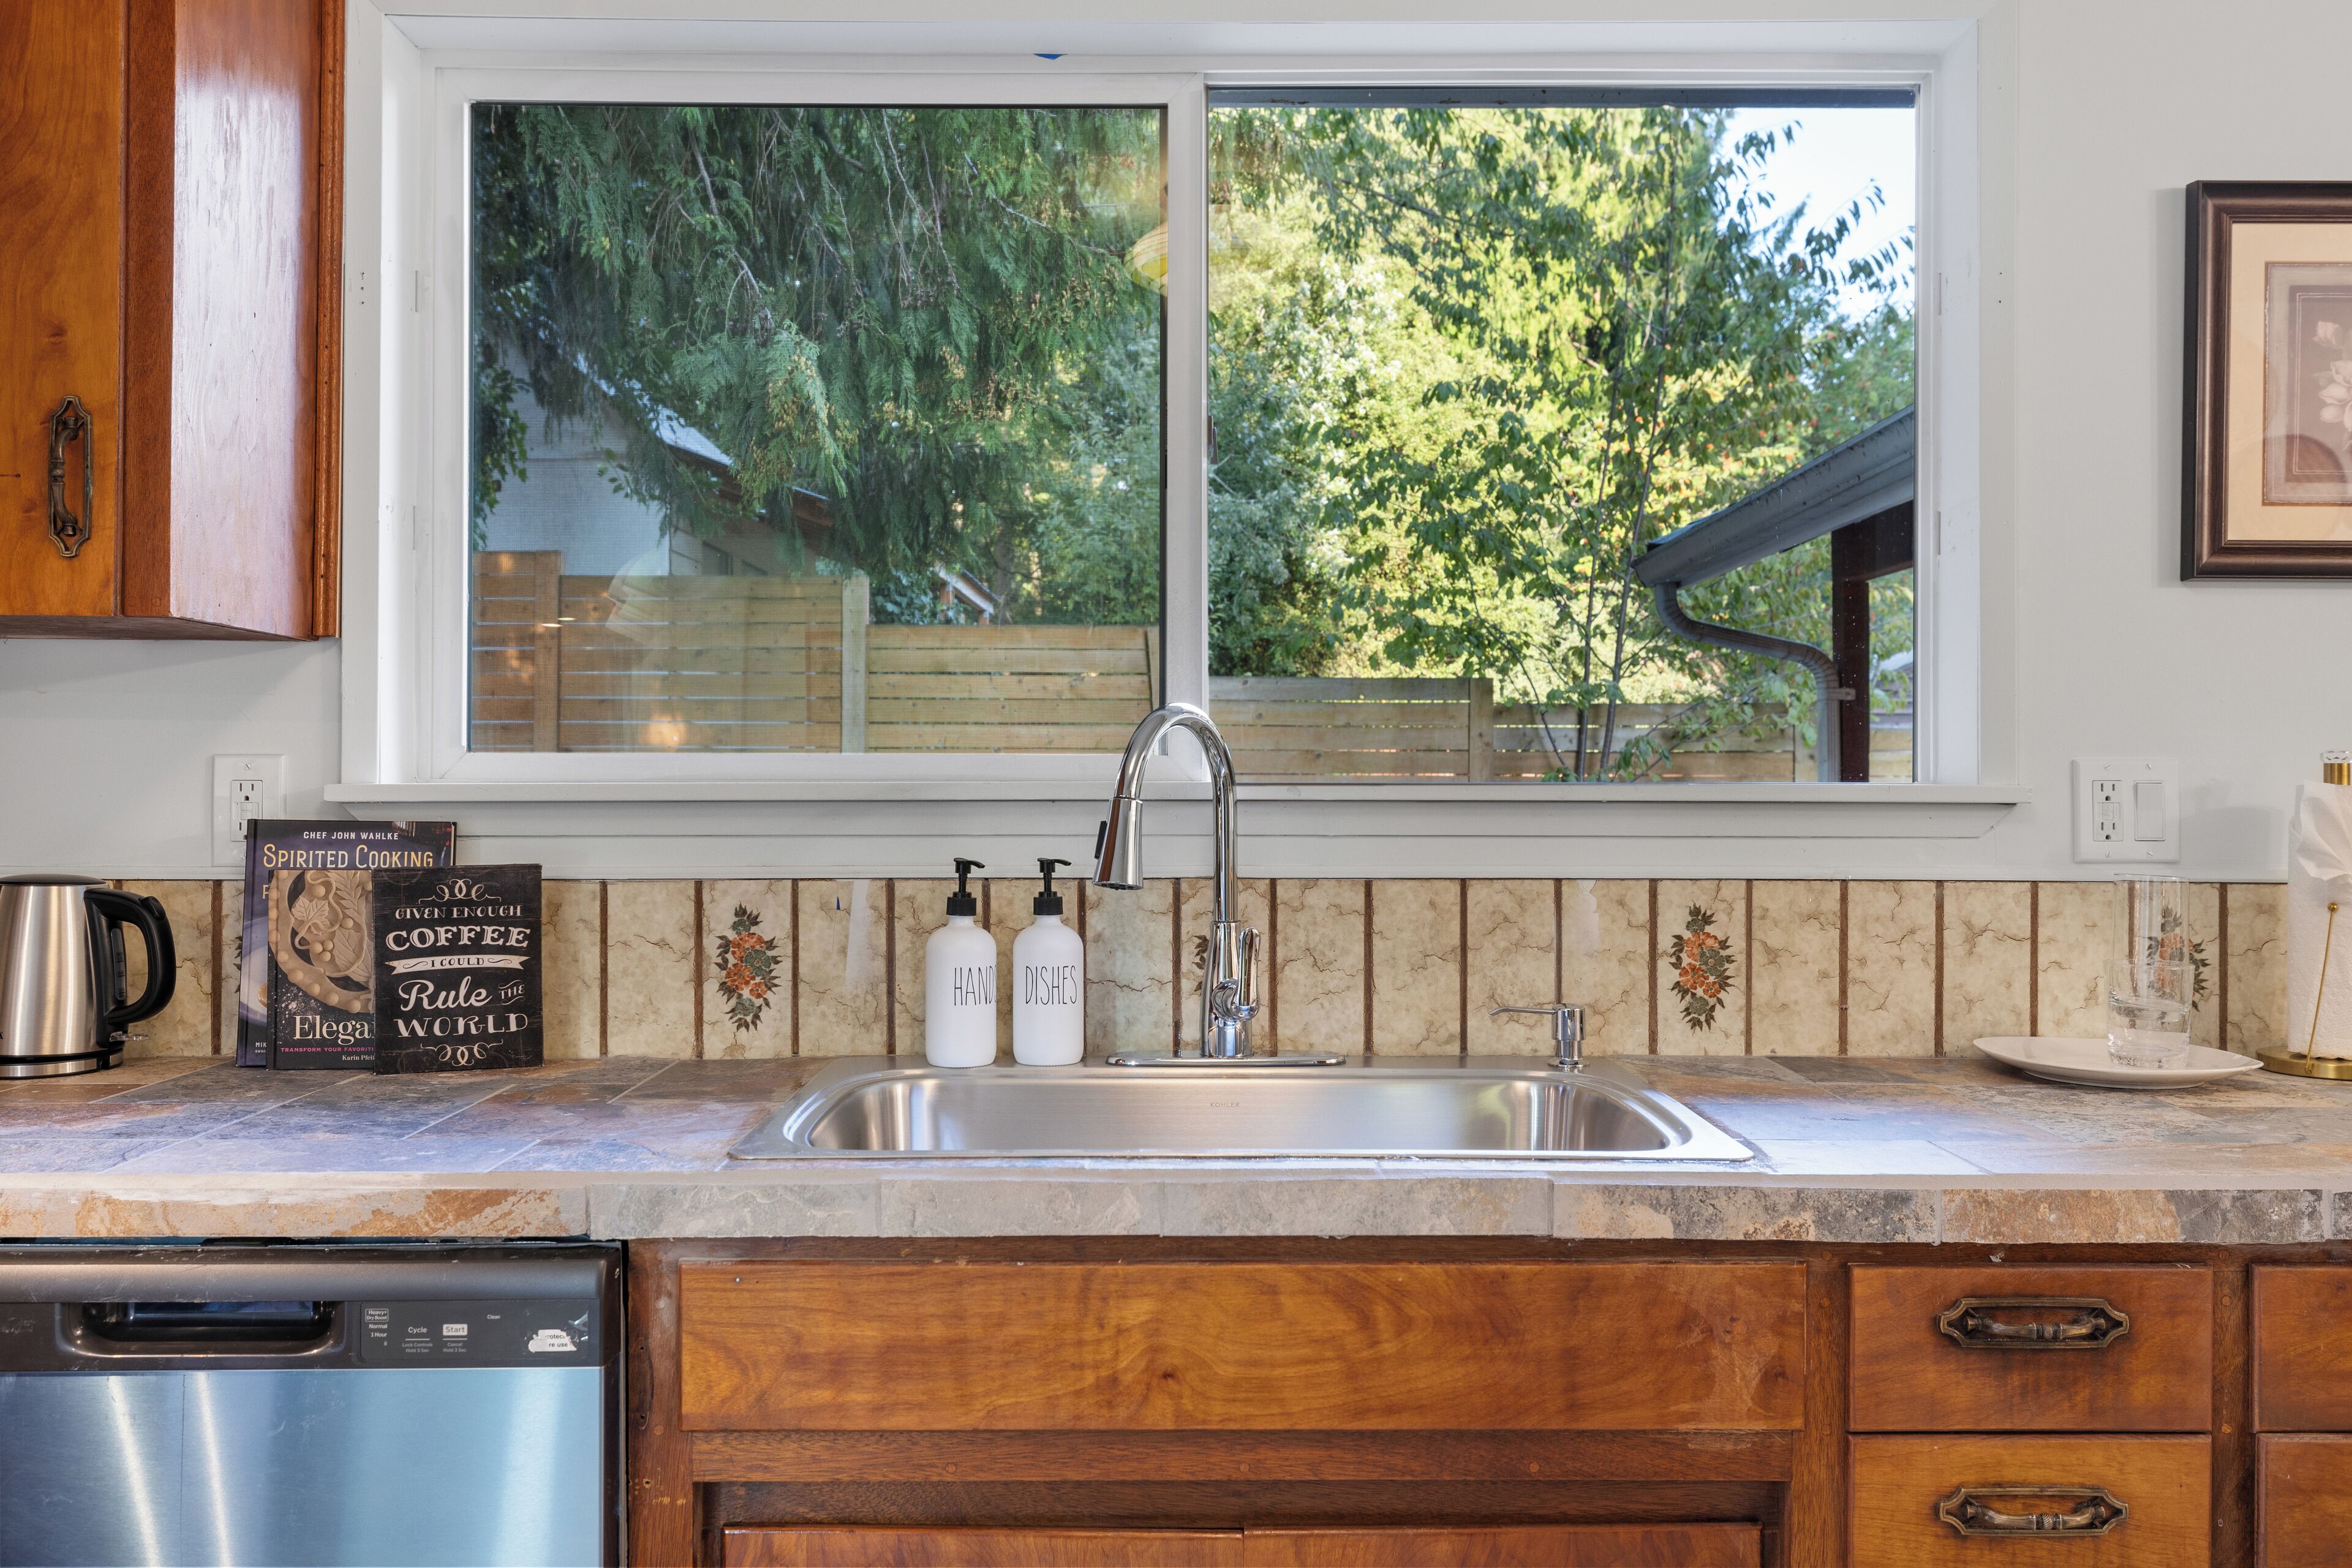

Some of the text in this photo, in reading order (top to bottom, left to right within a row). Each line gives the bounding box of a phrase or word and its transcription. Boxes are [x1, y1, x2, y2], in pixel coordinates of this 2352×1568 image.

[263, 843, 433, 868] SPIRITED COOKING
[395, 905, 523, 919] GIVEN ENOUGH
[385, 925, 531, 951] COFFEE
[430, 957, 484, 968] I COULD
[398, 976, 525, 1011] Rule THE
[1025, 965, 1077, 1005] DISHES
[293, 1015, 374, 1046] Elega
[393, 1013, 528, 1038] WORLD
